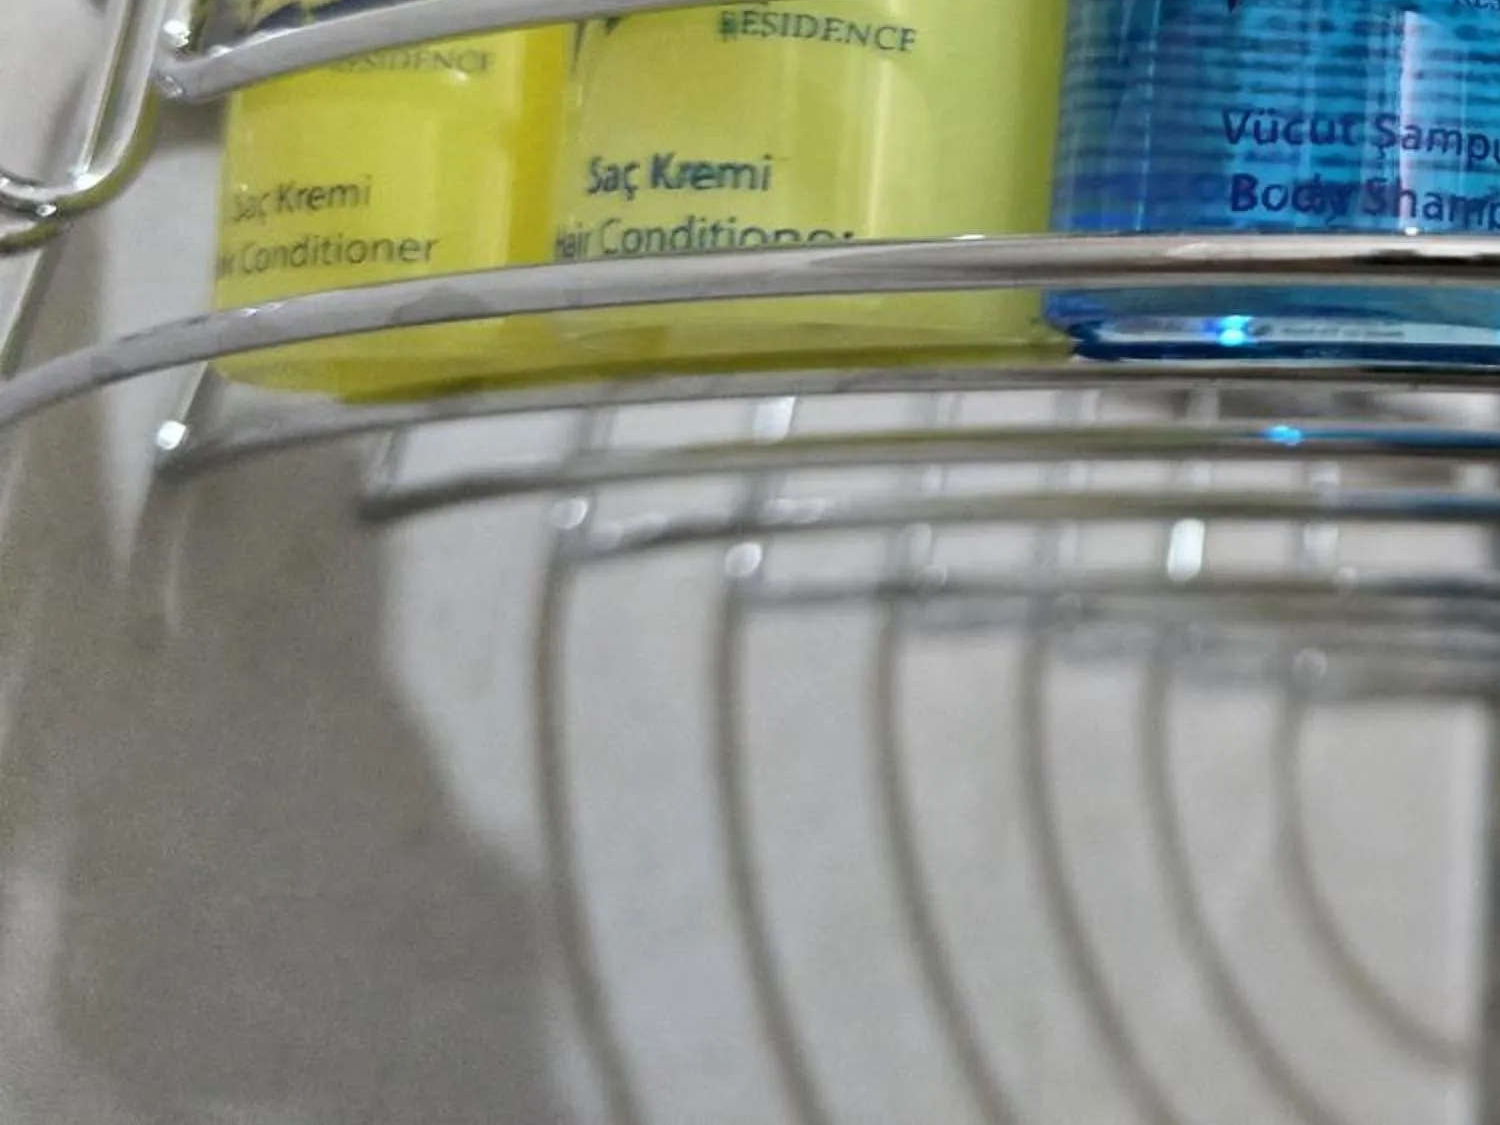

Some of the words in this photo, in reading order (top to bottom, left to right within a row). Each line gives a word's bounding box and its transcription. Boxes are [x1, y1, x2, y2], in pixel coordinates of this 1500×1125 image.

[650, 152, 773, 192] Kremi
[277, 174, 371, 215] Kremi
[241, 233, 440, 274] Conditioner
